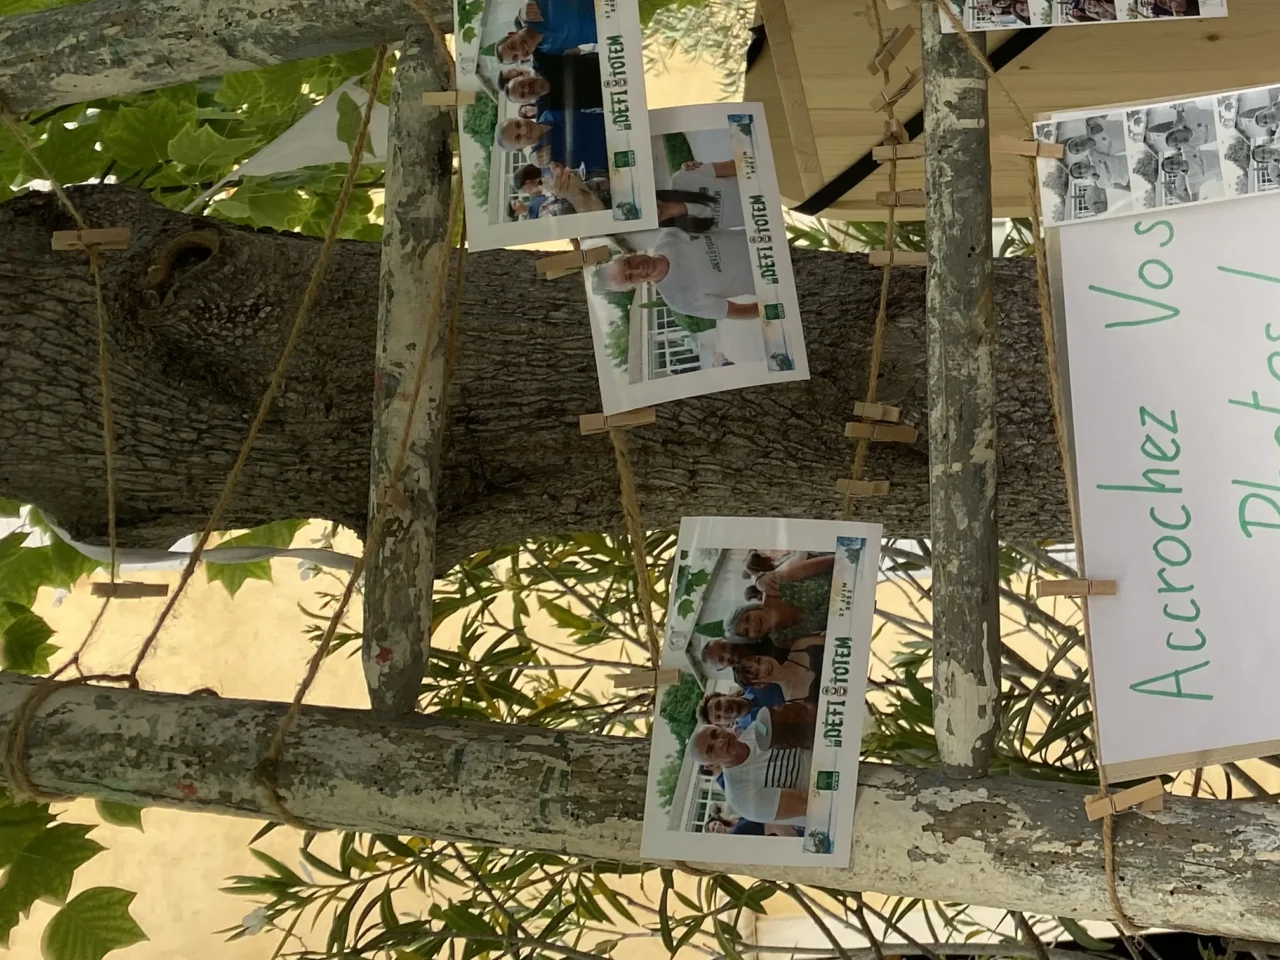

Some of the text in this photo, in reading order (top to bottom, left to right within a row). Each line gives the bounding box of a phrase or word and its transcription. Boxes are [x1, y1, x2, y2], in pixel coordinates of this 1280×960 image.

[606, 34, 626, 78] TOTEM
[749, 194, 770, 234] TOTEM
[1088, 219, 1214, 701] Accrochez Vos
[840, 582, 848, 603] JUIN
[830, 636, 852, 685] TOTEM
